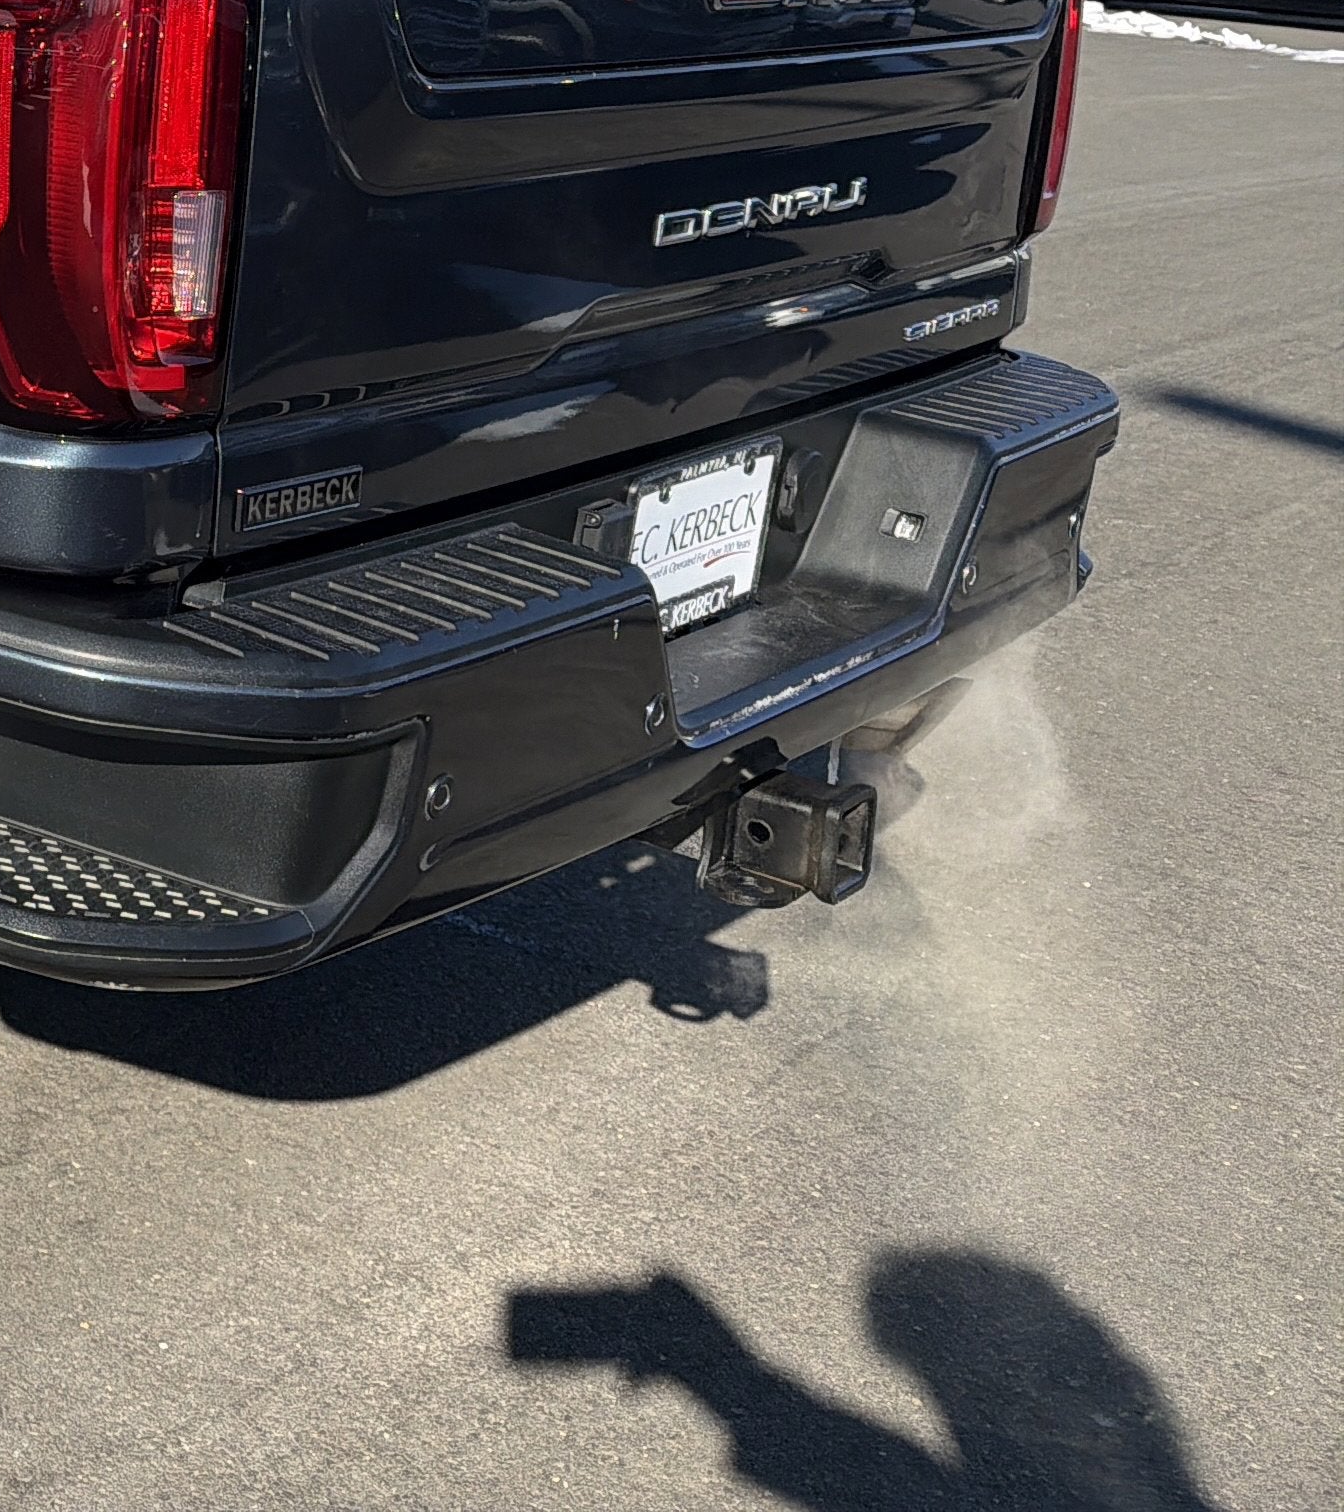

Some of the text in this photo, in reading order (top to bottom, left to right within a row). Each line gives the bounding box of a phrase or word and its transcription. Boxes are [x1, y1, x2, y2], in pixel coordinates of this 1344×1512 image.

[654, 175, 868, 248] DENALI
[903, 299, 1000, 342] SIERRA
[247, 474, 357, 525] KERBECK
[665, 490, 763, 555] KERBECK
[670, 585, 729, 629] KERBECK
